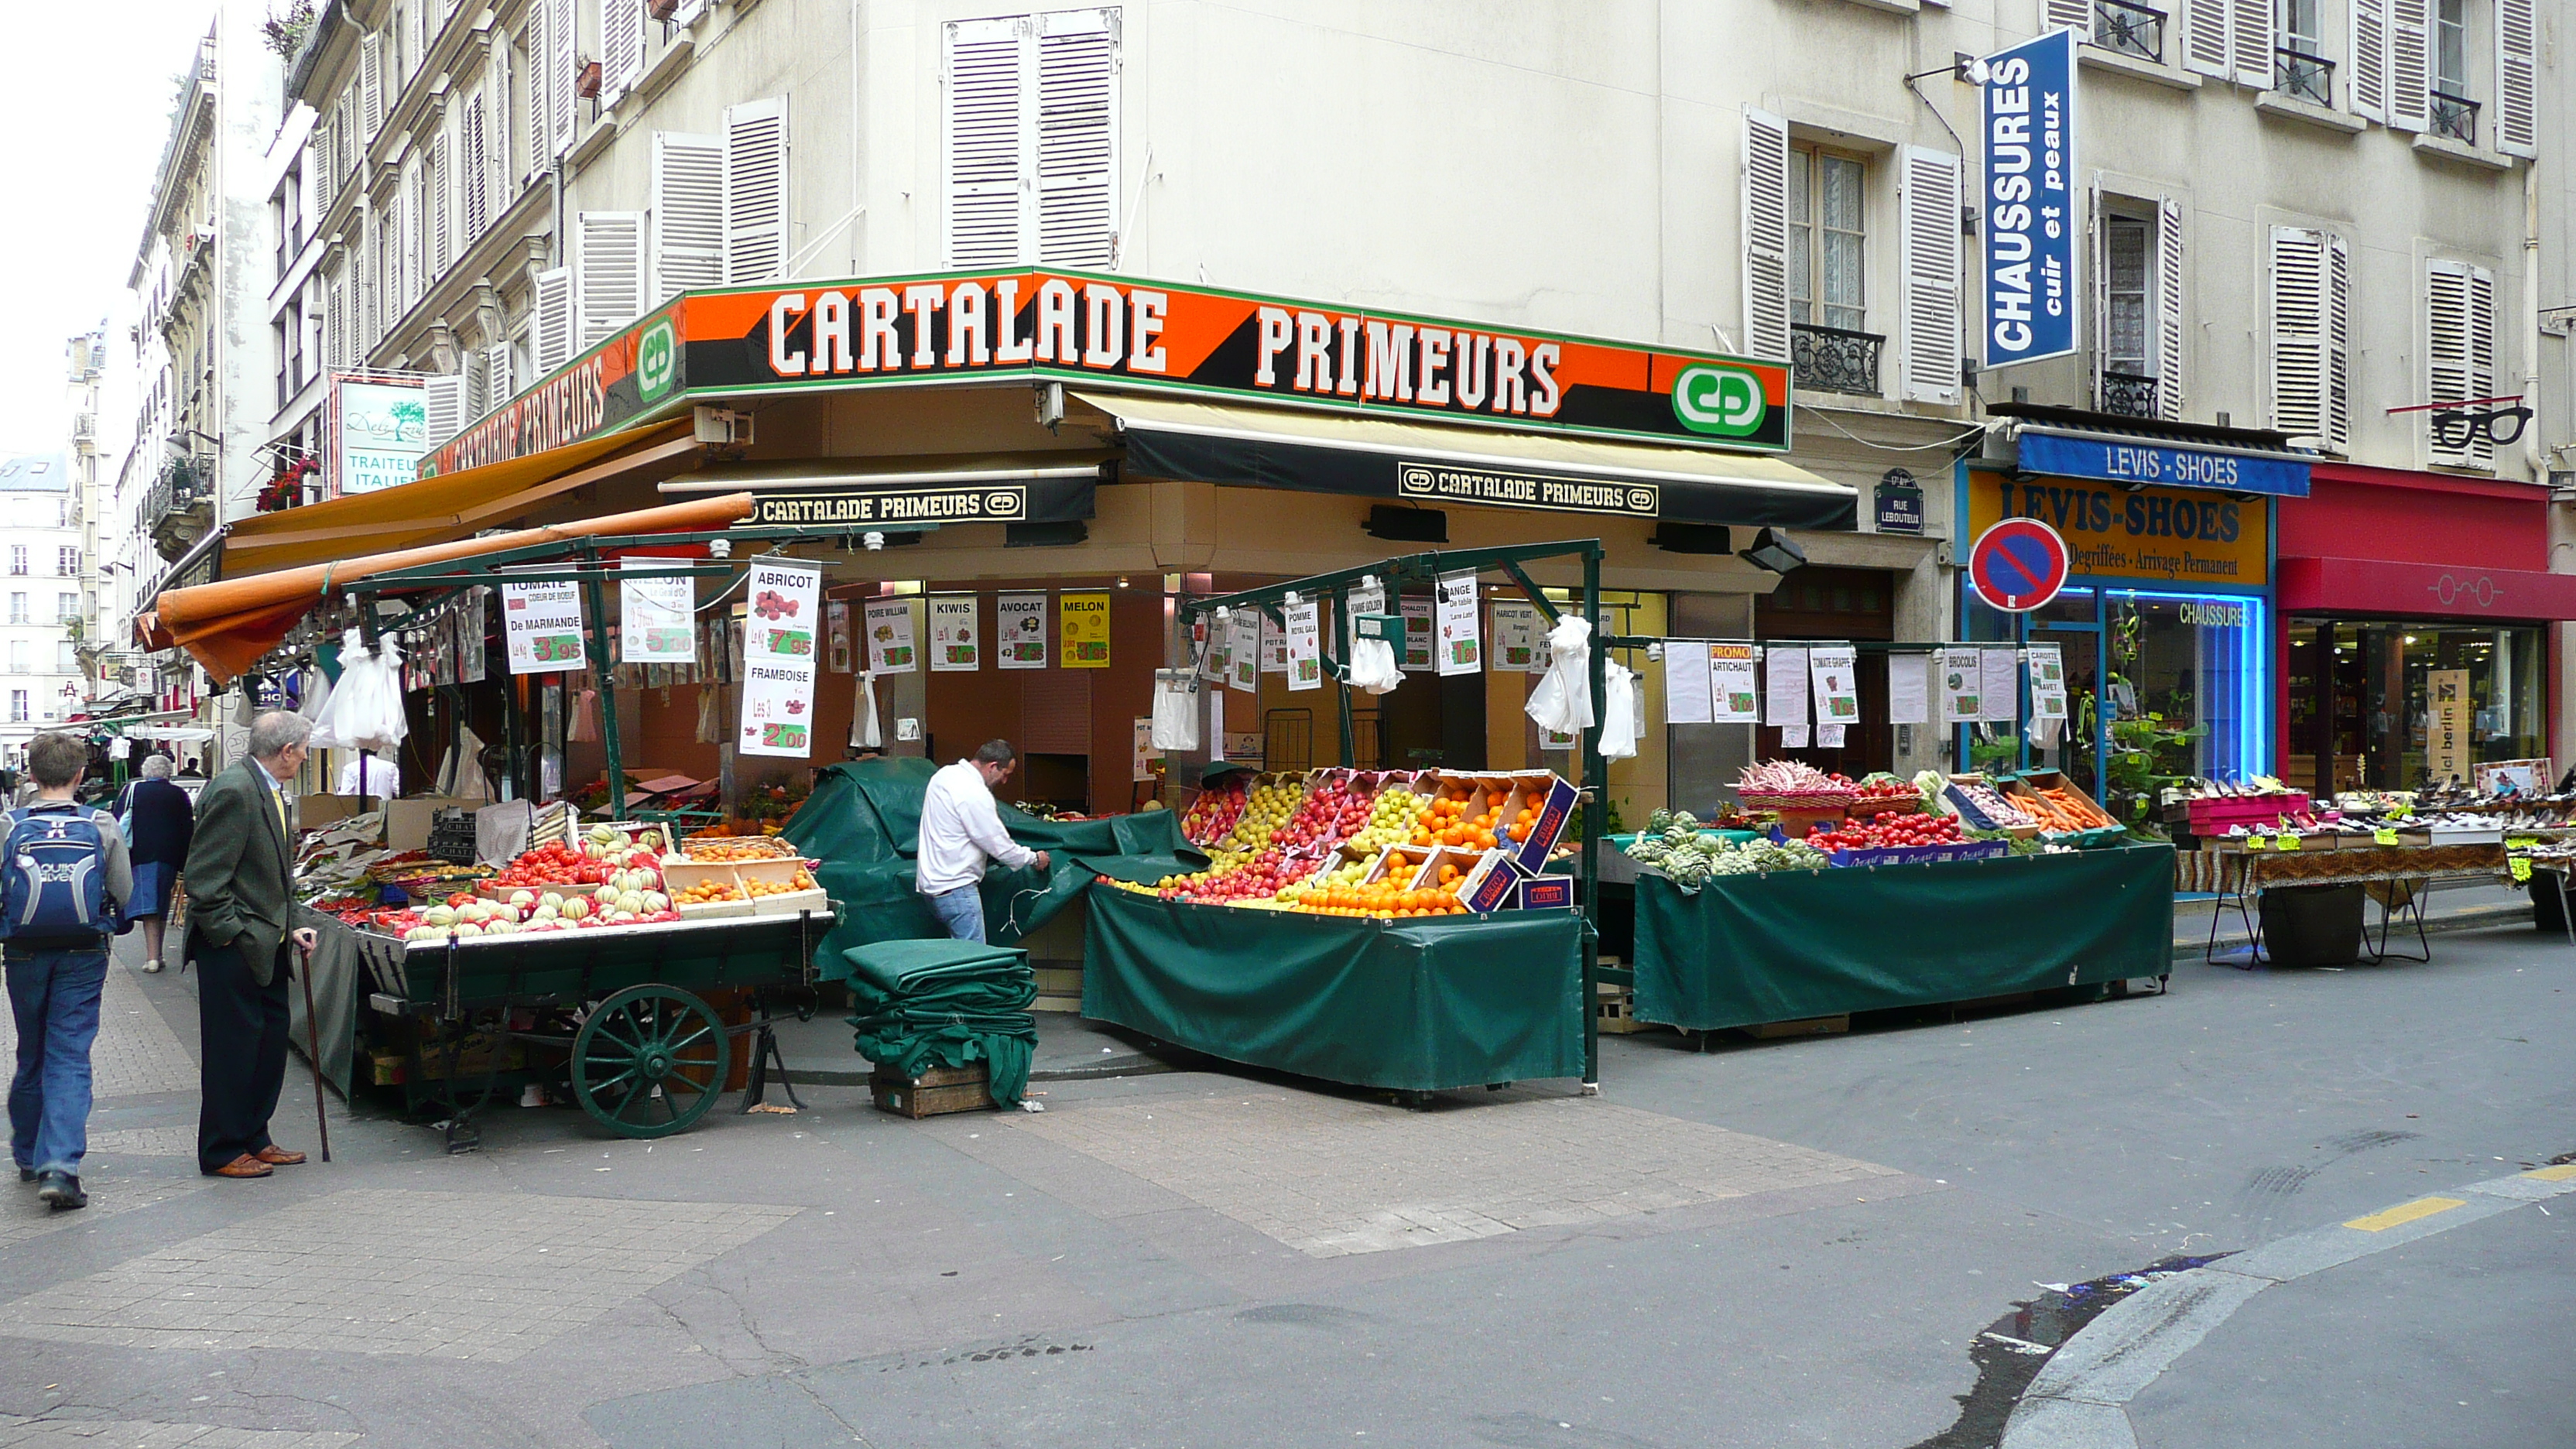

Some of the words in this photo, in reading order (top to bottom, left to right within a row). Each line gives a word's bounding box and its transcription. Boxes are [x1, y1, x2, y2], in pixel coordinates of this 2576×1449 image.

[2043, 91, 2064, 192] peaux
[1993, 57, 2033, 352] CHAUSSURES
[2040, 205, 2061, 240] et
[2040, 254, 2063, 317] cuir
[771, 278, 1168, 375] CARTALADE
[1255, 305, 1561, 418] PRIMEURS
[522, 355, 605, 456] PRIMEURS
[349, 455, 417, 471] TRAITEU
[2105, 446, 2160, 478] LEVIS
[2176, 454, 2239, 486] SHOES
[355, 473, 417, 487] ITALIE
[1437, 472, 1537, 502] CARTALADE
[1543, 481, 1625, 508] PRIMEURS
[762, 498, 874, 522] CARTALADE
[881, 493, 981, 519] PRIMEURS
[1893, 499, 1909, 512] RUE
[1881, 511, 1920, 524] LEBOUTEUX
[2135, 548, 2181, 581] Arrivage
[2183, 550, 2239, 576] Permanent
[757, 571, 814, 589] ABRICOT
[1449, 584, 1471, 597] ANGE
[937, 603, 971, 614] KIWIS
[1000, 602, 1043, 612] AVOCAT
[1064, 601, 1105, 612] MELON
[1495, 610, 1518, 618] HARICOT
[1519, 610, 1533, 618] VERT
[2179, 602, 2251, 628] CHAUSSURES
[511, 620, 523, 632] De
[526, 616, 581, 631] MARMANDE
[1288, 611, 1312, 623] POMME
[1711, 646, 1751, 659] PROMO
[1712, 661, 1752, 672] ARTICHAUT
[1948, 656, 1977, 668] BROCOLIS
[751, 666, 809, 683] FRAMBOISE
[2441, 707, 2454, 751] berlin
[1539, 813, 1557, 840] BRIO
[1482, 876, 1502, 901] BRIO
